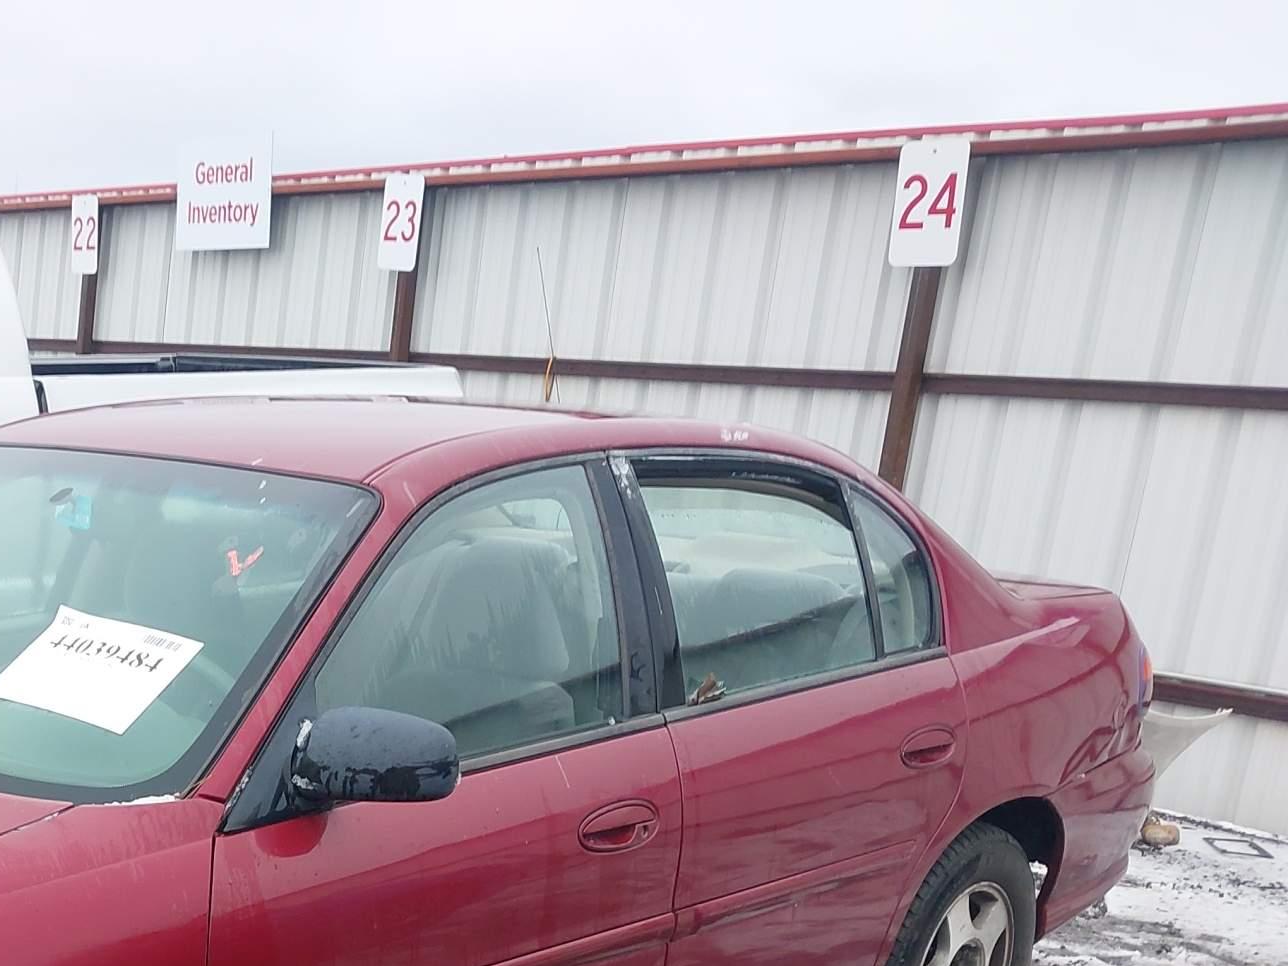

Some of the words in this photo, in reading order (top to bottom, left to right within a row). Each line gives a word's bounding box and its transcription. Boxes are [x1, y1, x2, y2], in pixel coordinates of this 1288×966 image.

[195, 156, 254, 185] General
[187, 200, 260, 228] Inventory
[898, 172, 957, 232] 24
[73, 216, 96, 251] 22
[382, 199, 418, 243] 23
[50, 634, 164, 673] 44039484
